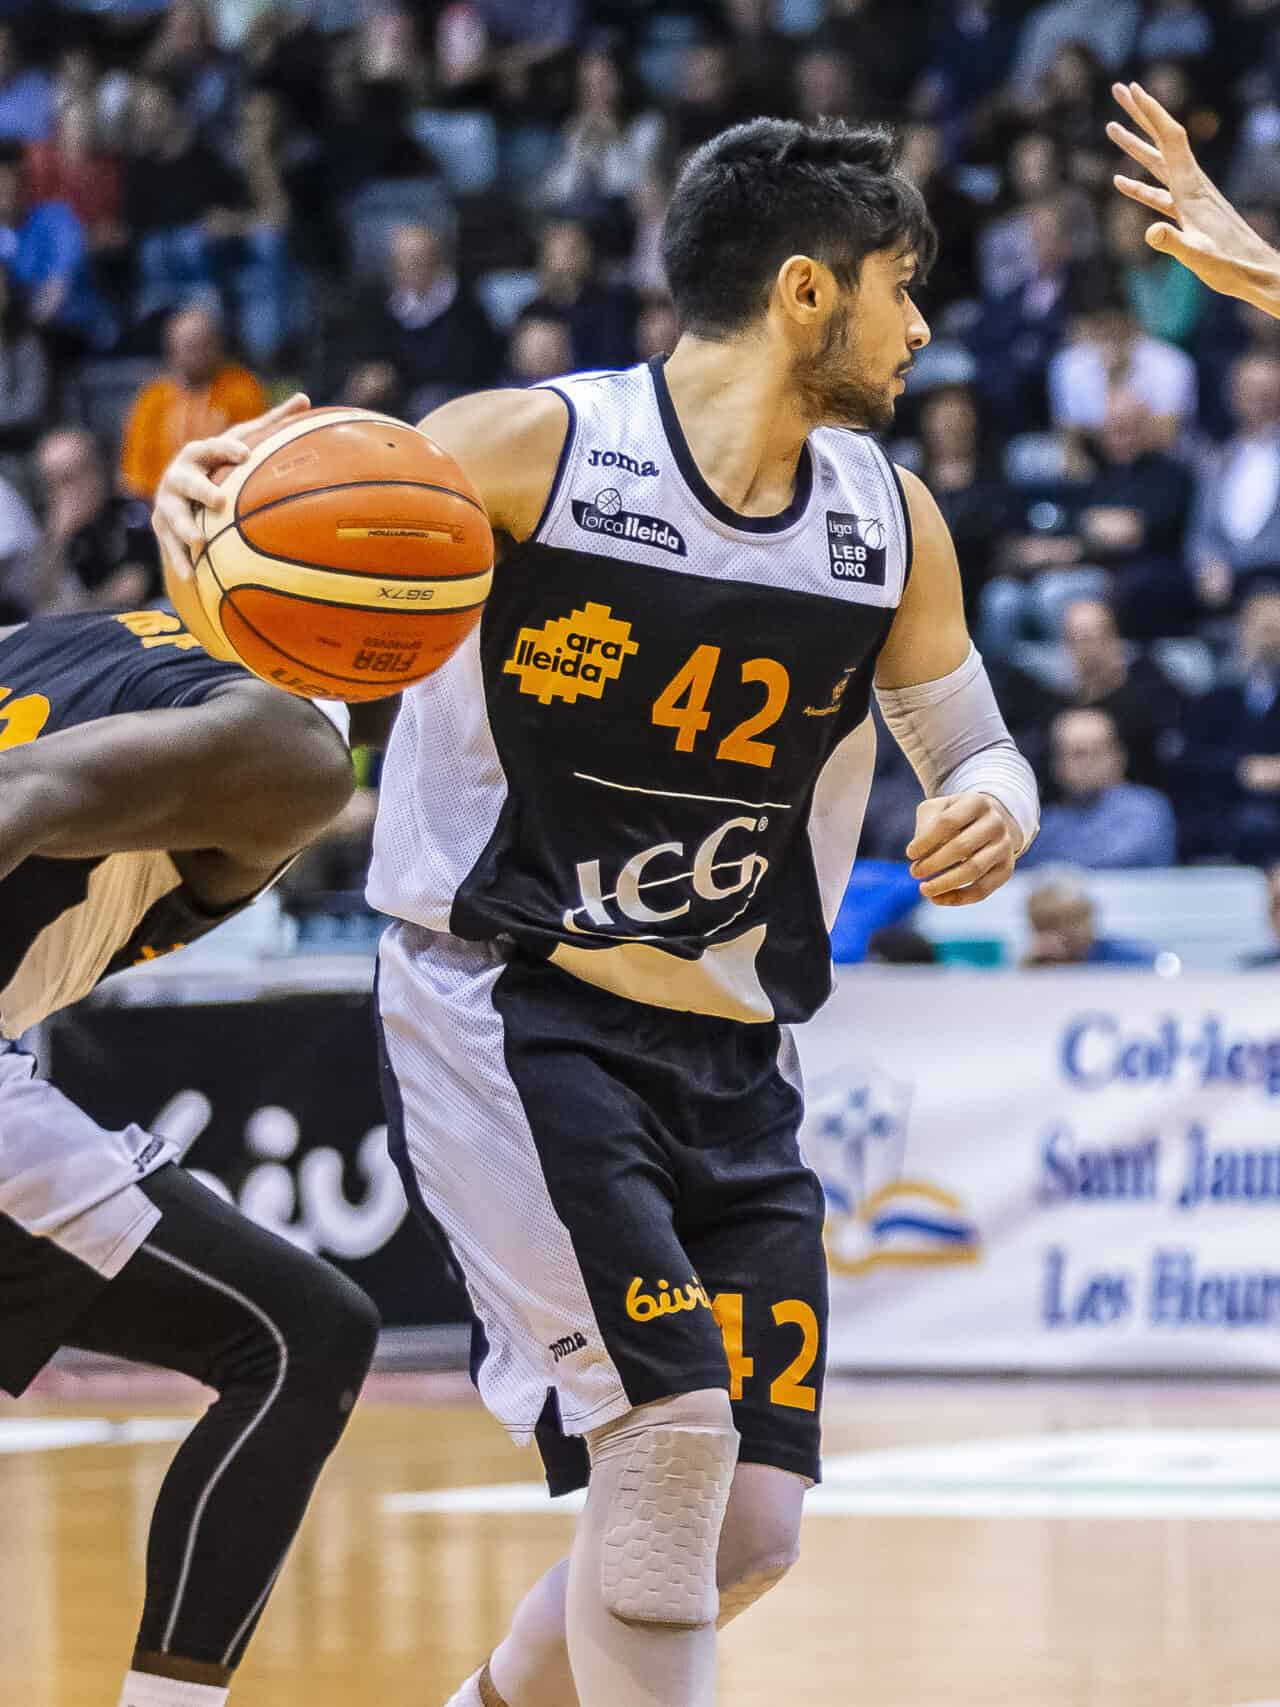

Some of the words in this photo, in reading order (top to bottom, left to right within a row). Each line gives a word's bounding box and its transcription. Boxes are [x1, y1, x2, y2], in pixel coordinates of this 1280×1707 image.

[831, 543, 867, 561] LEB
[833, 560, 866, 579] ORO
[351, 649, 418, 674] FIBA
[516, 639, 602, 684] lleida
[566, 632, 622, 661] ara
[652, 643, 791, 769] 42
[1040, 1120, 1159, 1200] Sant
[711, 1292, 820, 1413] 42
